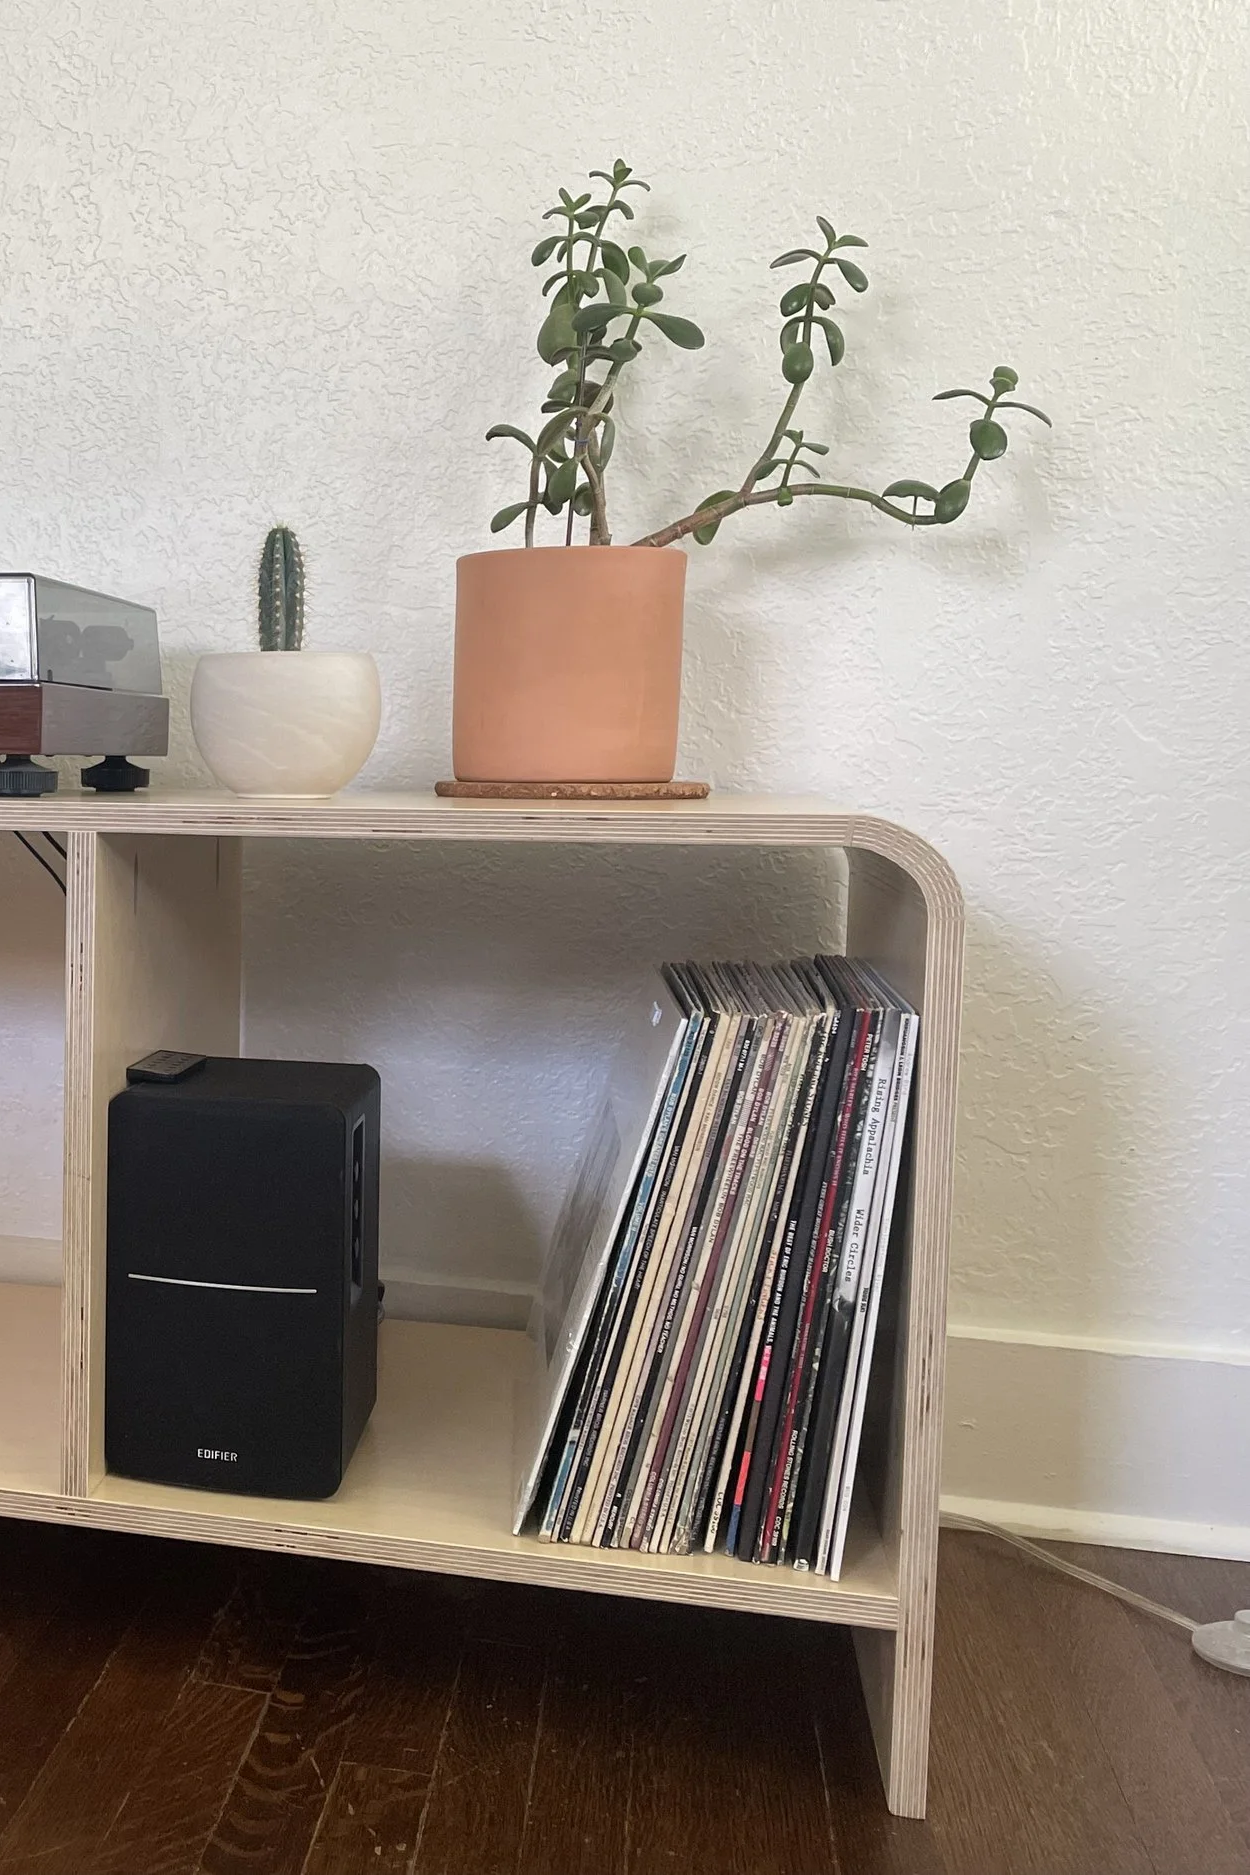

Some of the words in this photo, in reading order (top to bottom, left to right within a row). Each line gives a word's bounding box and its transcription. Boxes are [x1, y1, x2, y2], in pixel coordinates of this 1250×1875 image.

[862, 1033, 874, 1053] PETER
[859, 1053, 869, 1071] TOSH
[870, 1078, 887, 1112] Rising
[860, 1117, 880, 1175] Appalachia
[787, 1219, 797, 1231] THE
[851, 1208, 865, 1237] Wider
[824, 1229, 836, 1247] BUSH
[820, 1248, 832, 1272] DOCTOR
[843, 1242, 859, 1282] Circles
[786, 1429, 798, 1455] ROLLING
[197, 1448, 238, 1462] EDIFIER
[782, 1456, 793, 1480] STONES
[776, 1479, 789, 1509] RECORDS
